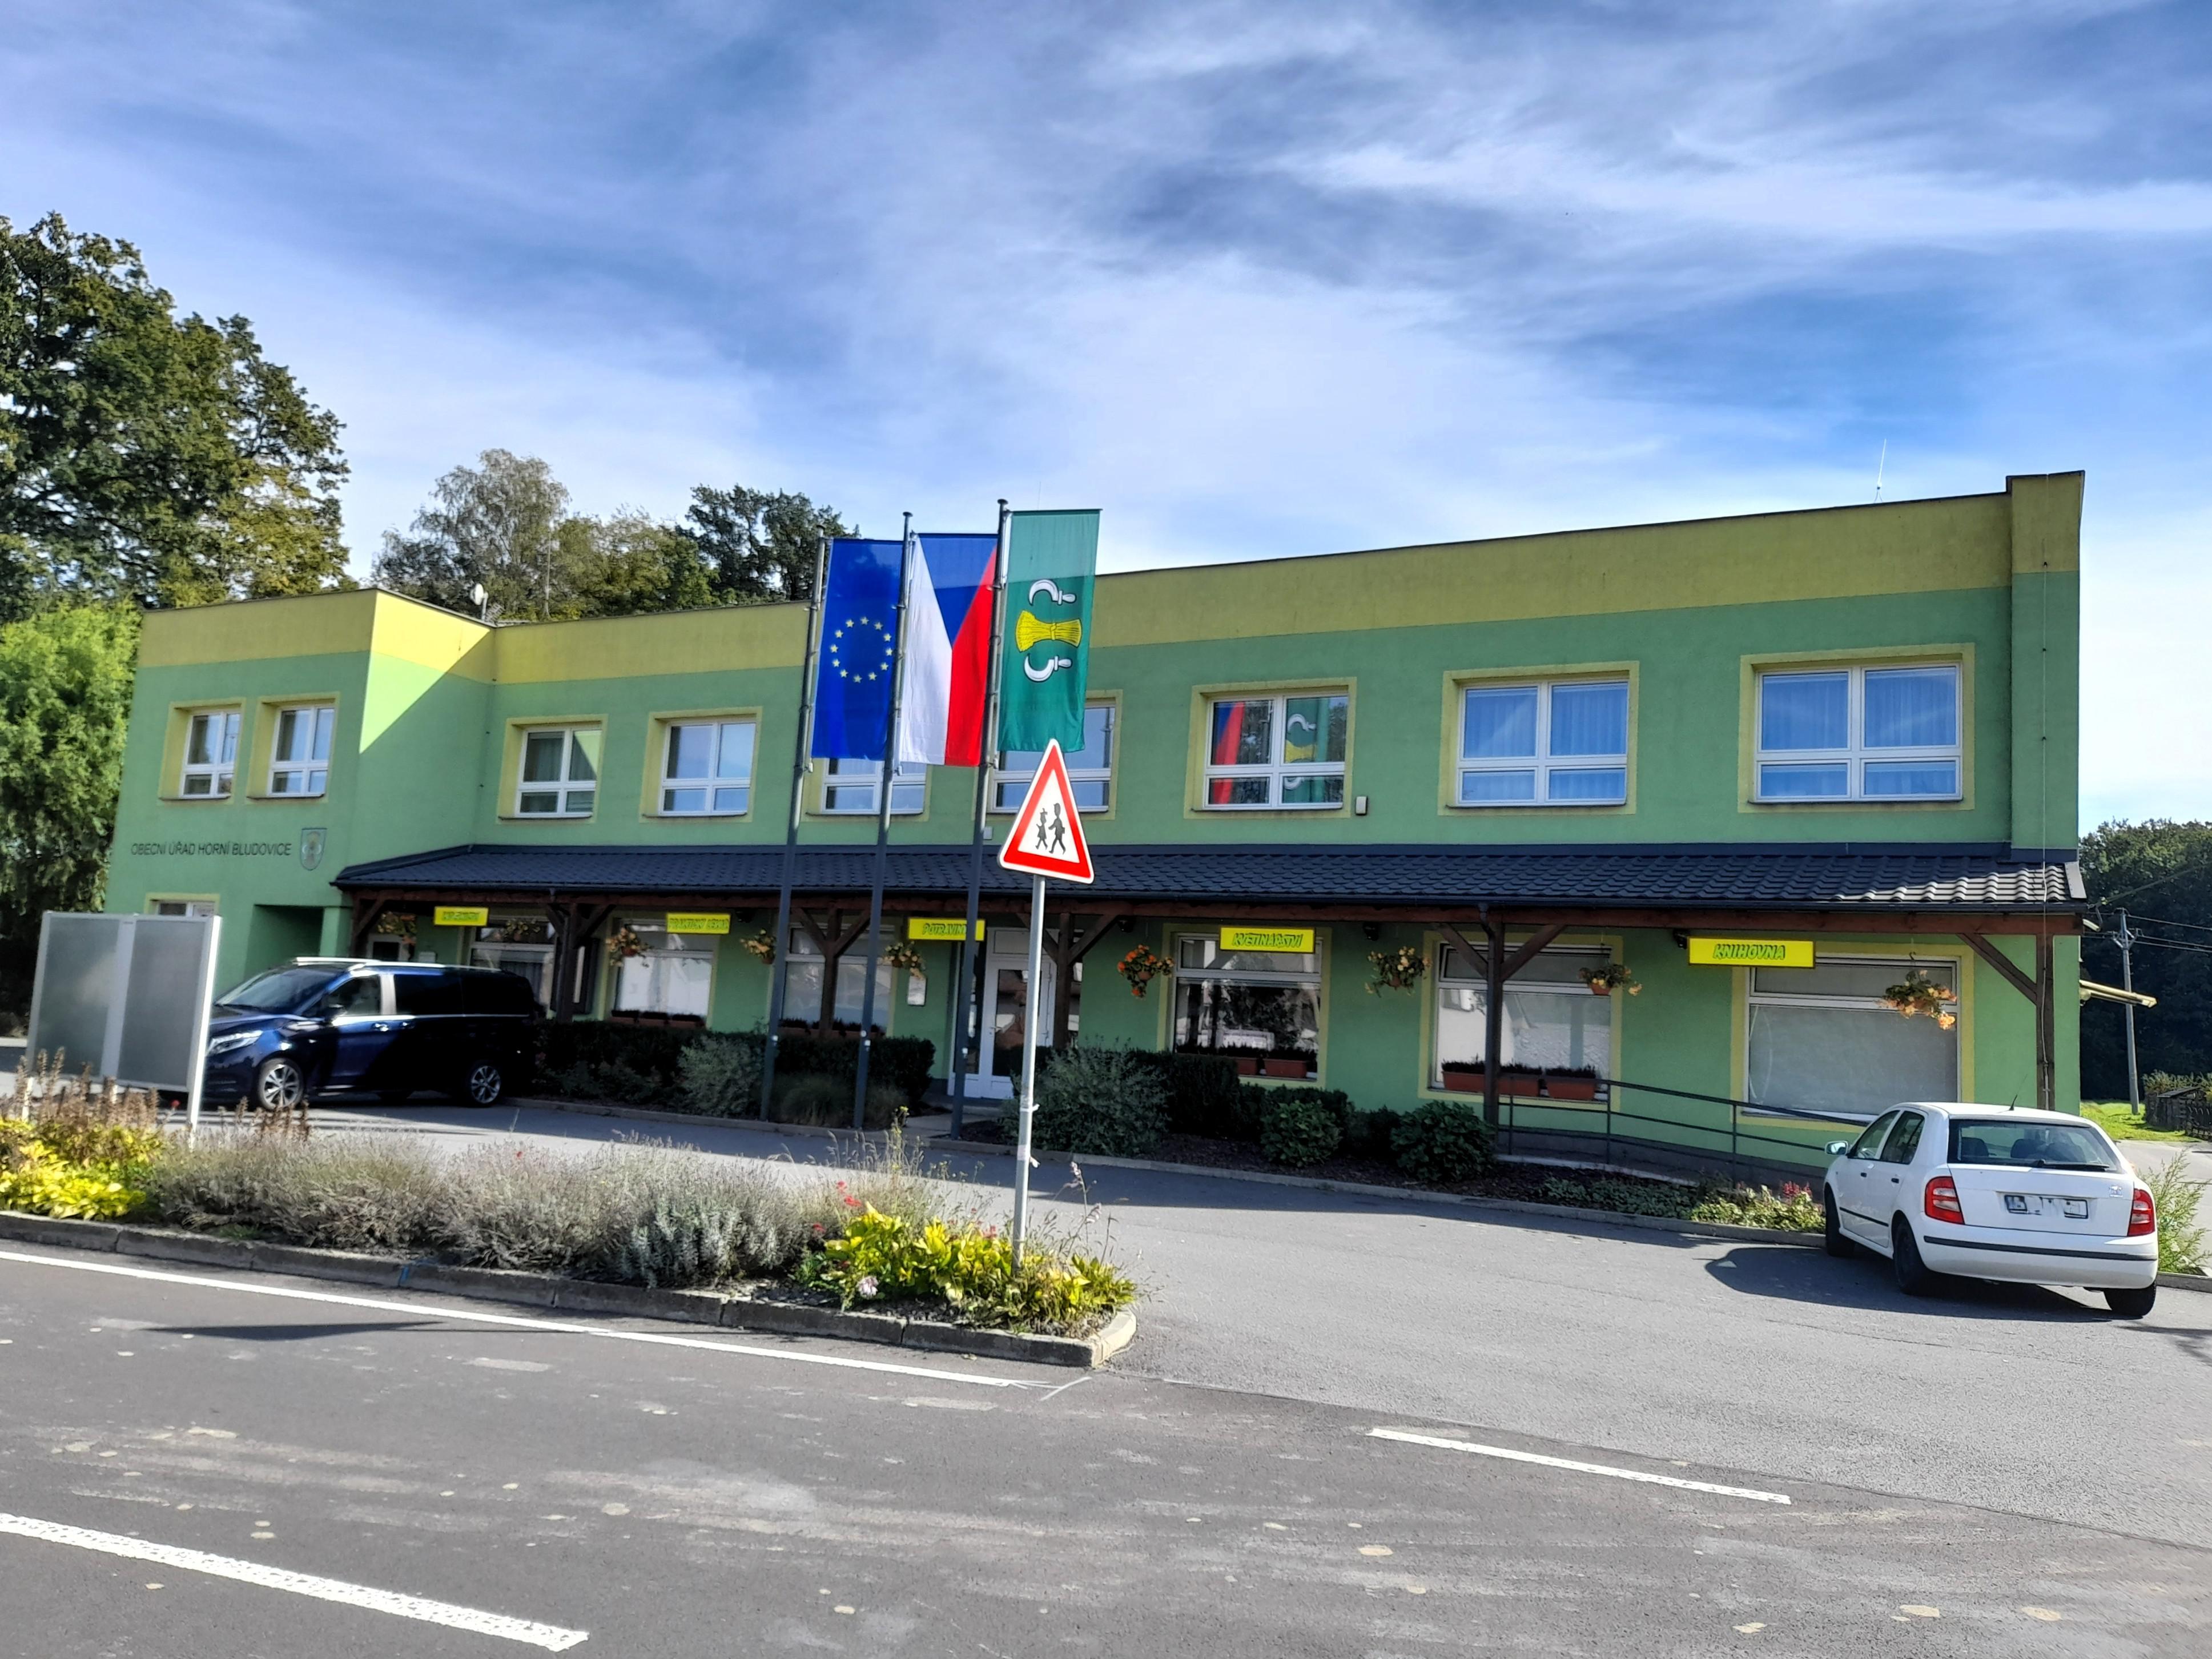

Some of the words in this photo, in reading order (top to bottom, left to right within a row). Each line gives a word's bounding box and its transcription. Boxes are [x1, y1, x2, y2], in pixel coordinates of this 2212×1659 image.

[198, 841, 231, 855] HORNÍ
[232, 842, 292, 855] BLUDOVICE
[922, 923, 967, 935] POTRAVIN
[1713, 943, 1785, 960] KNIHOVNA
